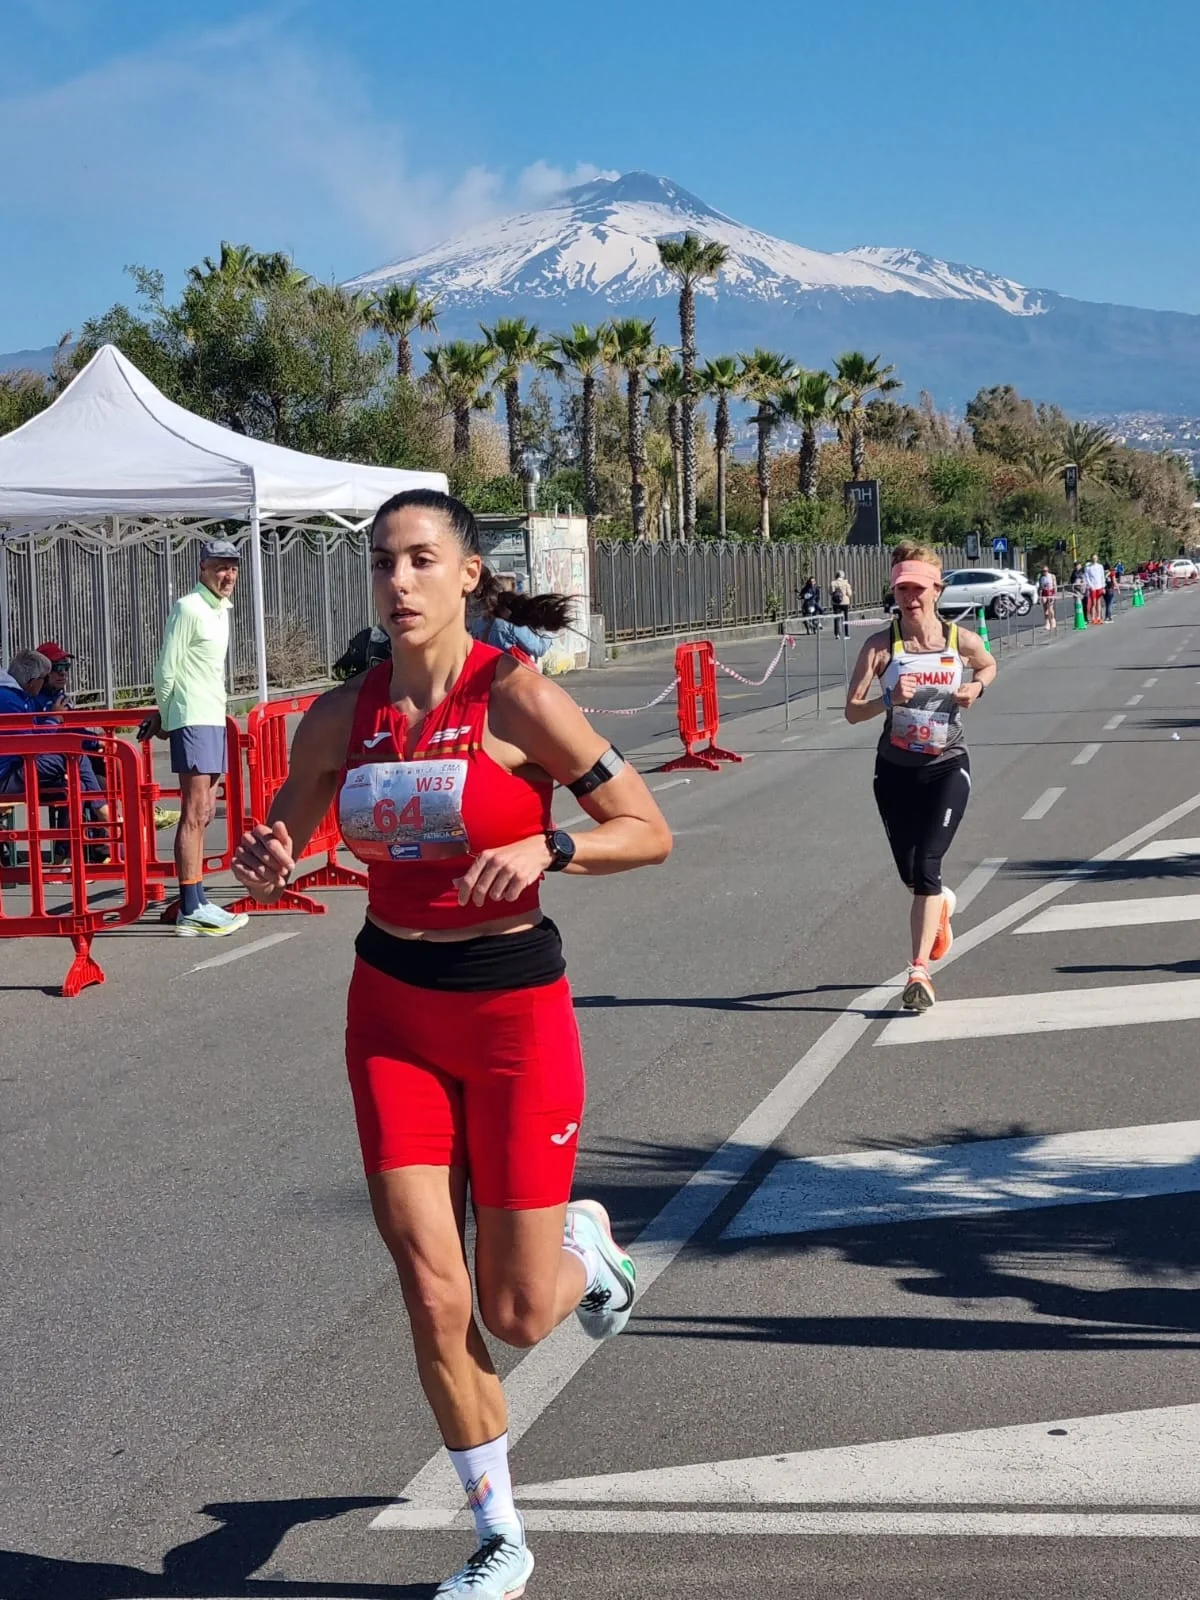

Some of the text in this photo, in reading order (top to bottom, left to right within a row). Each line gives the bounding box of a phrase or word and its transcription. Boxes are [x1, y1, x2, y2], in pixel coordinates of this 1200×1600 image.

[899, 671, 955, 686] RMANY
[428, 726, 472, 744] ESP
[905, 724, 931, 741] 29
[417, 776, 454, 793] W35
[373, 795, 424, 834] 64
